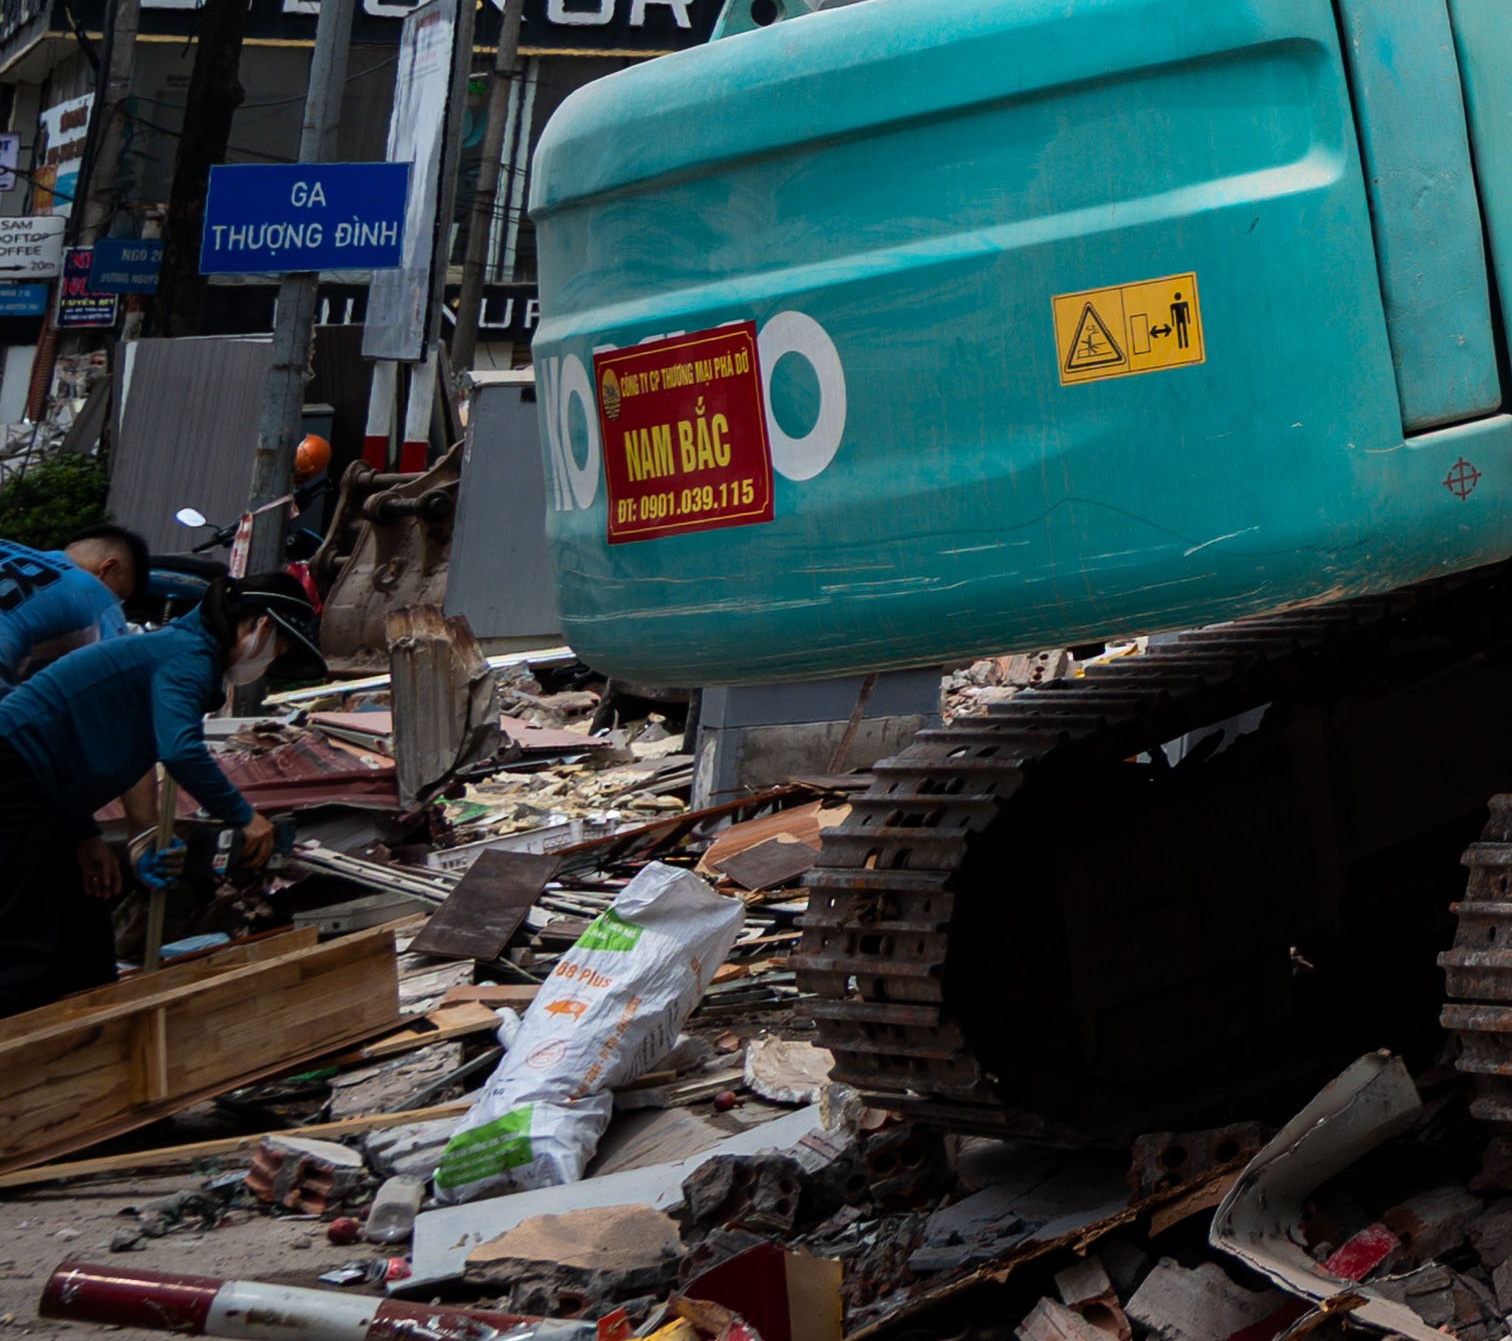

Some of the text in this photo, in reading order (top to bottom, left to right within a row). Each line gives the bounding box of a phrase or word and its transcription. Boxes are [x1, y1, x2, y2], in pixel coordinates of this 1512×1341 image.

[291, 181, 326, 208] GA
[211, 215, 398, 257] THƯỢNG ĐÌNH
[621, 372, 639, 398] CÔNG
[639, 372, 649, 394] TY
[662, 363, 694, 390] THƯƠNG
[694, 359, 713, 387] MẠI
[623, 395, 731, 483] NAM BẮC
[617, 478, 754, 524] ĐT: 0901.039.115
[577, 963, 613, 990] Plus
